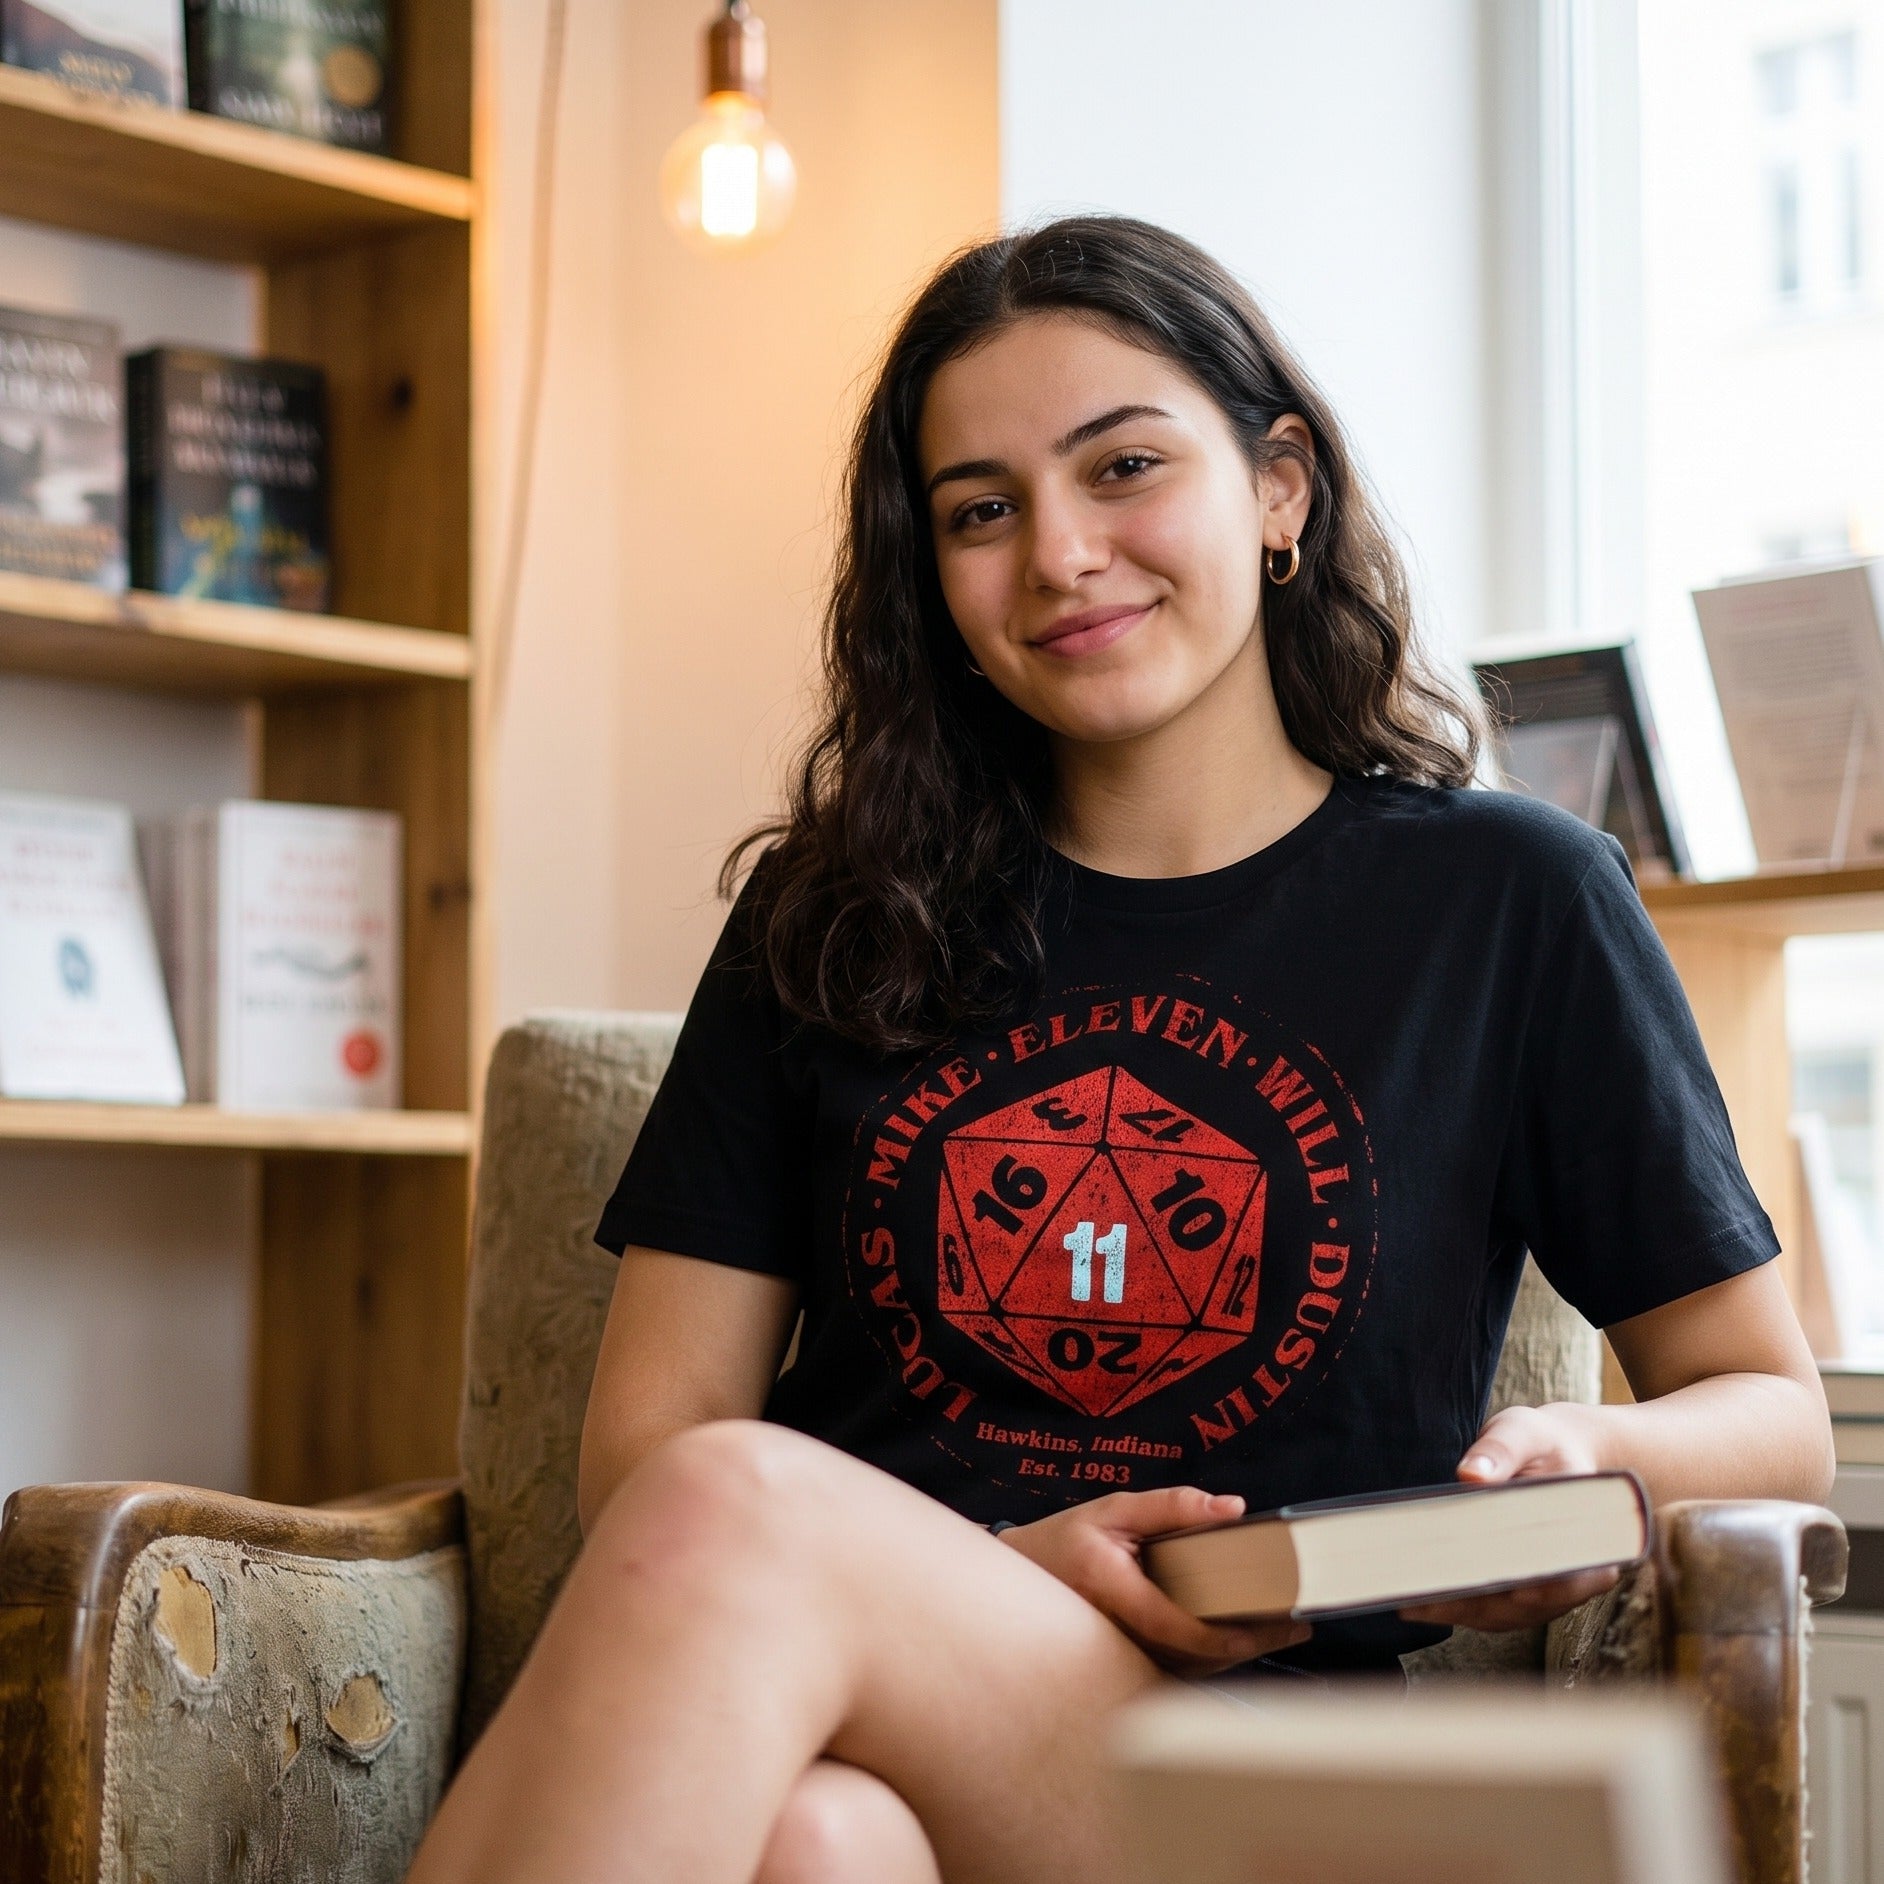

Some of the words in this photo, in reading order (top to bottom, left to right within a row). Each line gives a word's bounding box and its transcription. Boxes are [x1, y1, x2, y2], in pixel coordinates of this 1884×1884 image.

[1008, 994, 1250, 1069] ELEVEN
[868, 1057, 983, 1191] MIKE
[1032, 1096, 1088, 1131] 3
[1119, 1108, 1196, 1143] 17
[1254, 1055, 1350, 1206] WILL
[973, 1154, 1048, 1236] 16
[1151, 1168, 1228, 1252] 10
[1063, 1221, 1128, 1304] 11
[861, 1226, 979, 1424] LUCAS
[1047, 1327, 1143, 1375] 20
[1189, 1242, 1351, 1452] DUSTIN
[975, 1421, 1082, 1453] Hawkins,
[1091, 1435, 1184, 1460] Indiana
[1018, 1458, 1061, 1478] Est.
[1071, 1461, 1132, 1485] 1983
